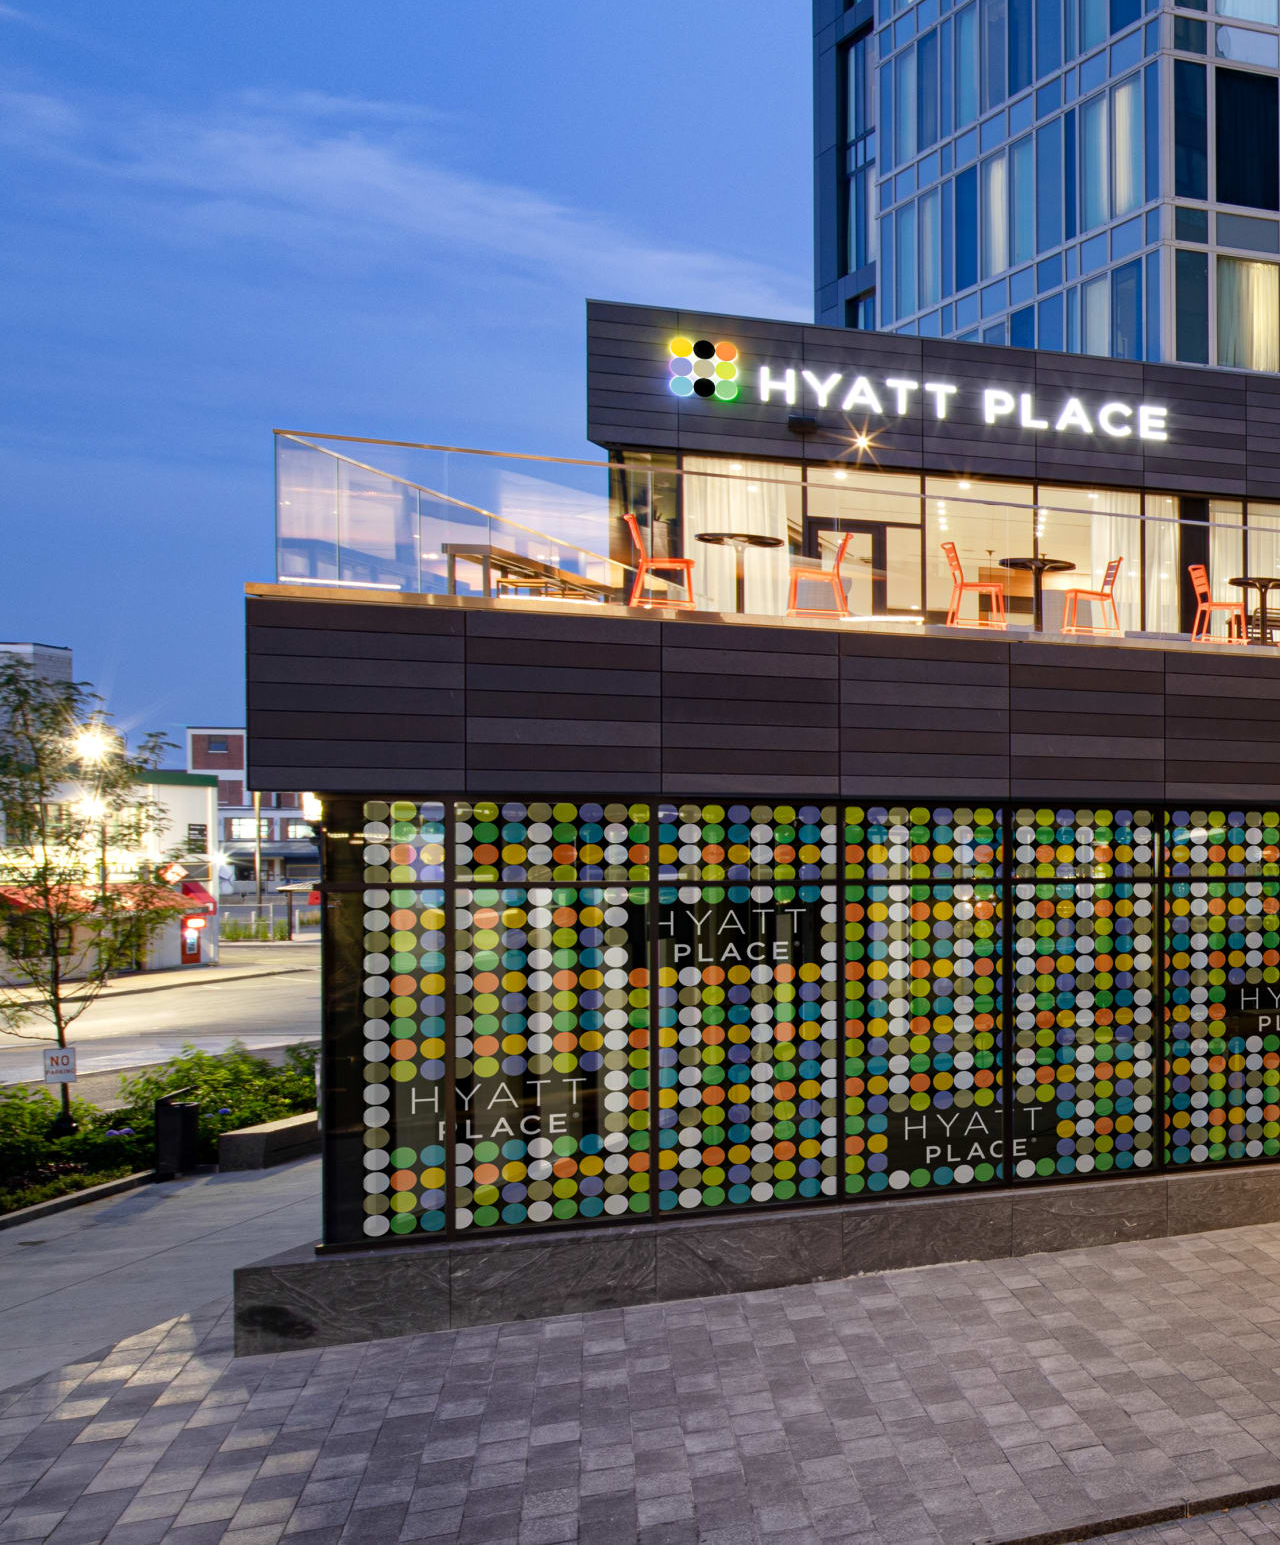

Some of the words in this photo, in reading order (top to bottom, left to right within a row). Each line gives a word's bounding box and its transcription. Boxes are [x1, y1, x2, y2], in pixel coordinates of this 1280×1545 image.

[759, 366, 957, 419] HYATT
[984, 389, 1168, 440] PLACE
[674, 941, 789, 963] PLACE
[50, 1055, 70, 1066] NO
[411, 1078, 587, 1115] HYATT
[904, 1107, 1043, 1141] HYAT
[926, 1138, 1028, 1164] PLACE
